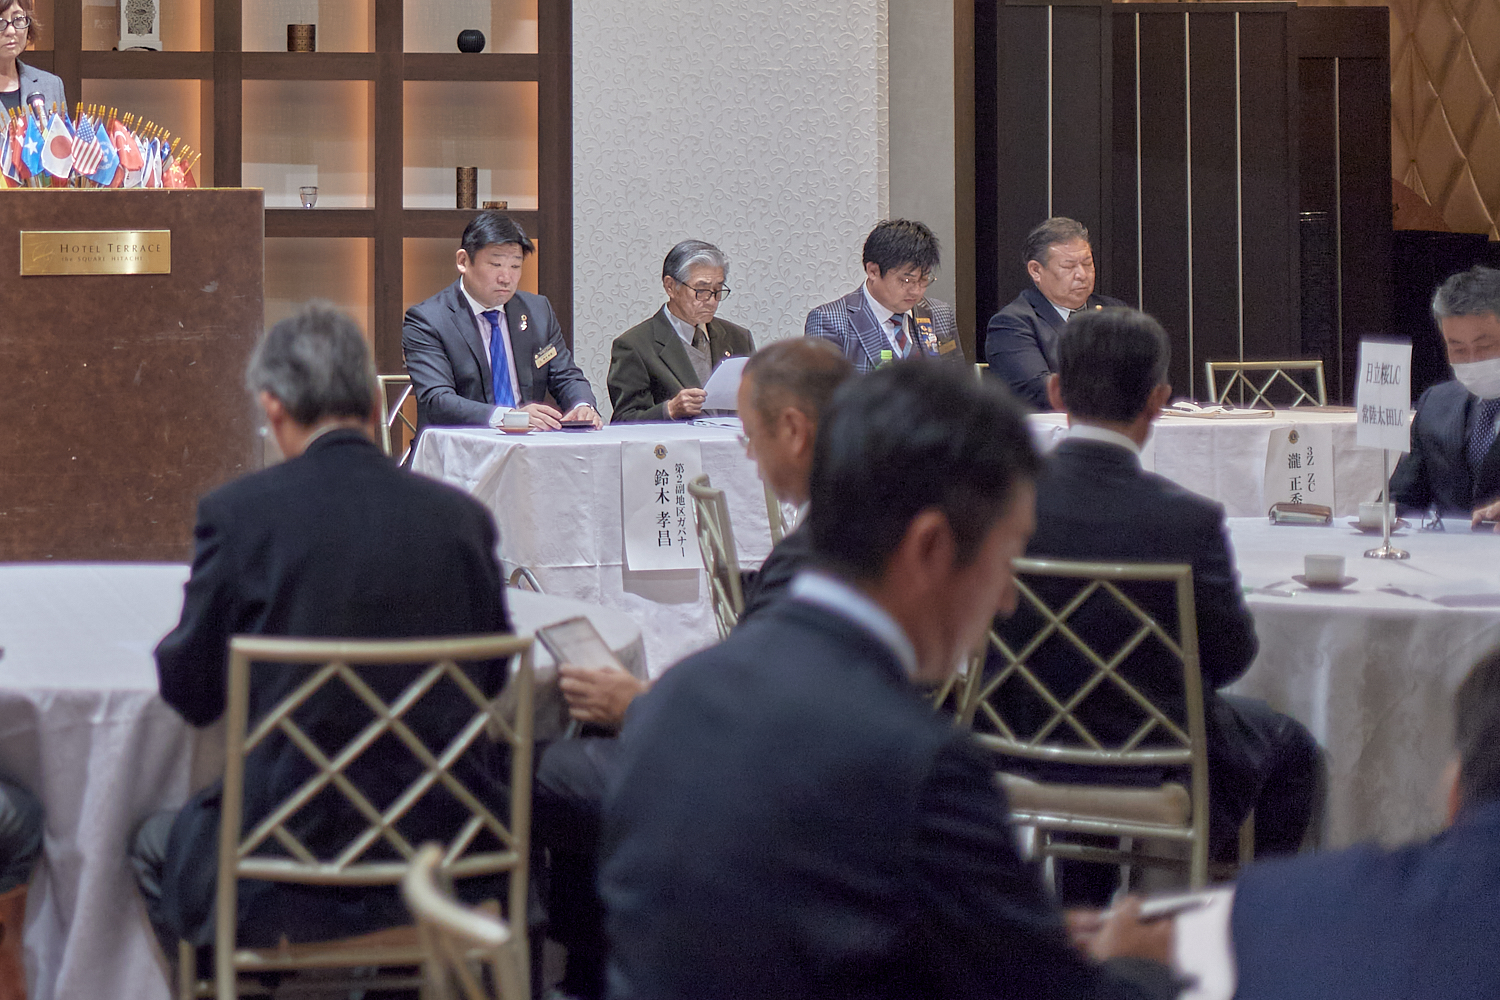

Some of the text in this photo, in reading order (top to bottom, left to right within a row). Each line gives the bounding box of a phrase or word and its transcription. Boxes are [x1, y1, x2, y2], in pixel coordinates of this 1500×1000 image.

[60, 243, 161, 253] HOTEL TERRACE
[654, 469, 672, 547] 鈴木 孝昌
[674, 463, 687, 558] 第2副地区ガバナー
